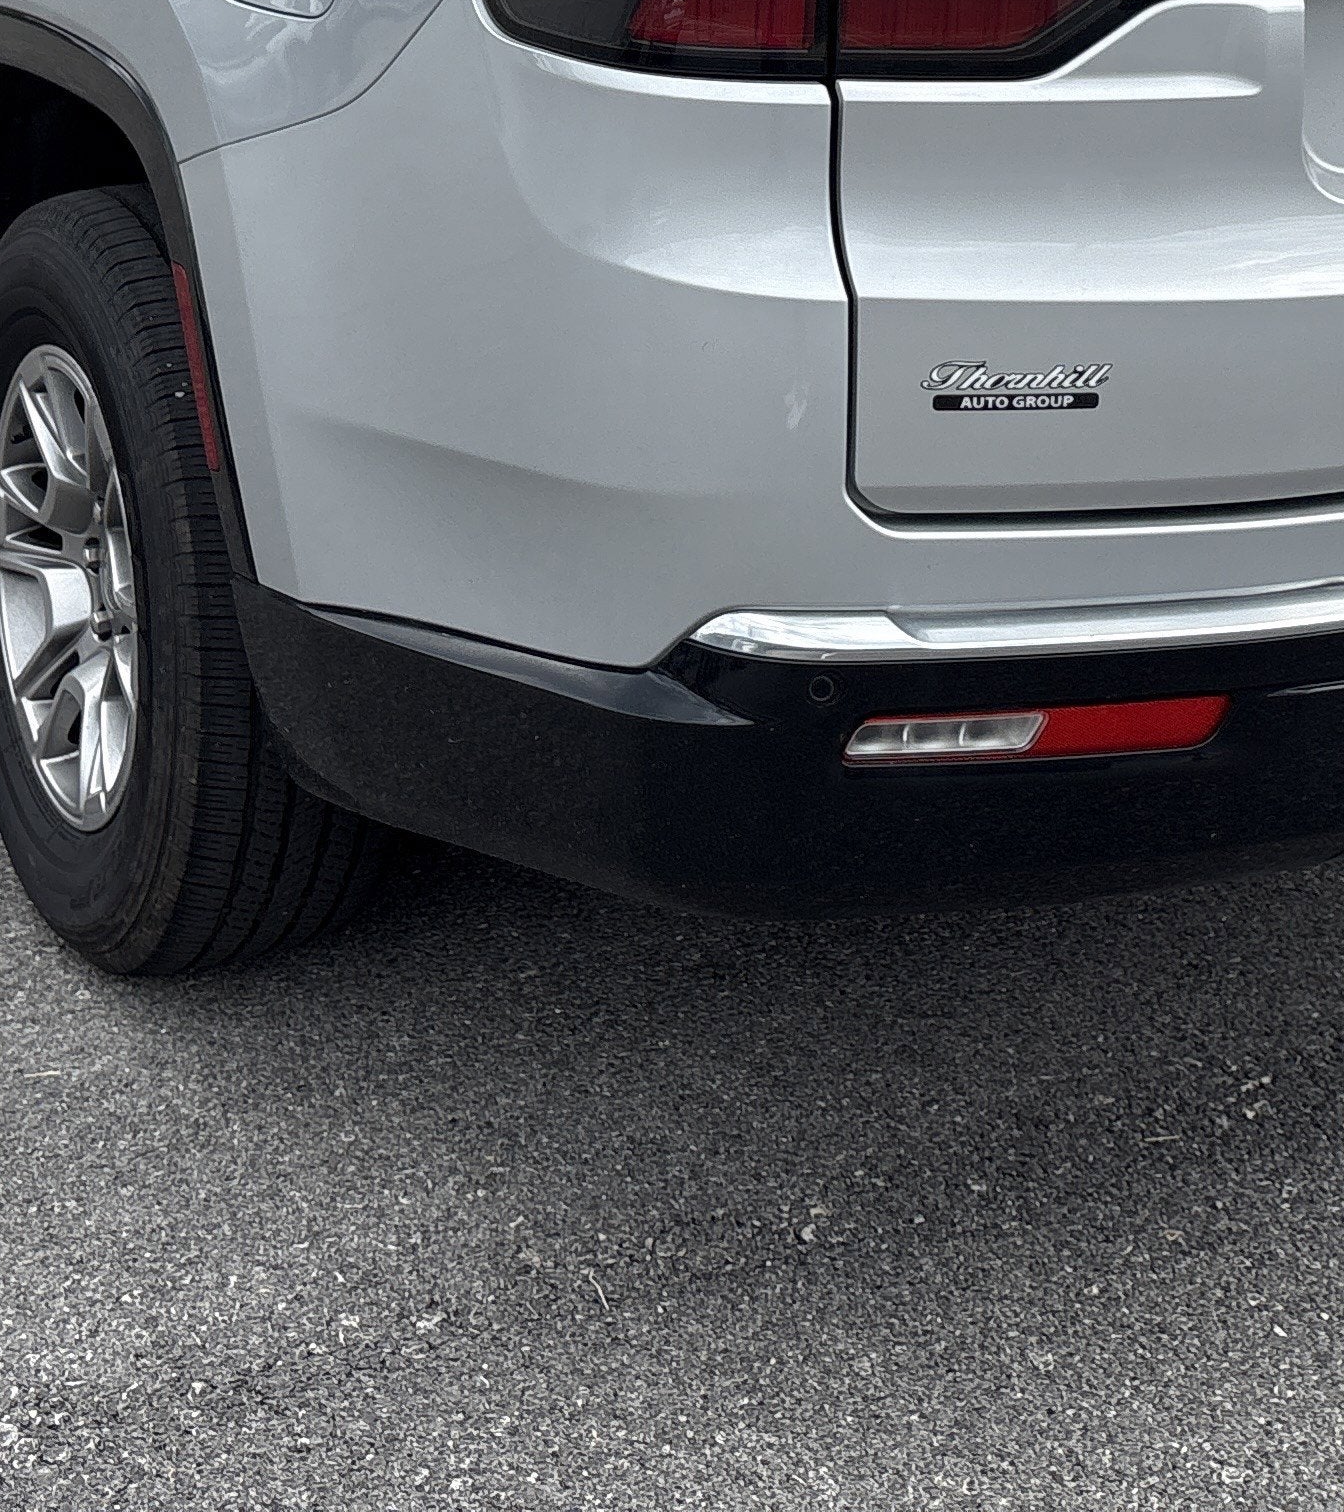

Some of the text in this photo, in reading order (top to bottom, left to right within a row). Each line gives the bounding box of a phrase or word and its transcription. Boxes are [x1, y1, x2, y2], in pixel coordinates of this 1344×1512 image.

[920, 360, 1113, 390] Thornhill
[960, 395, 1074, 409] AUTO GROUP
